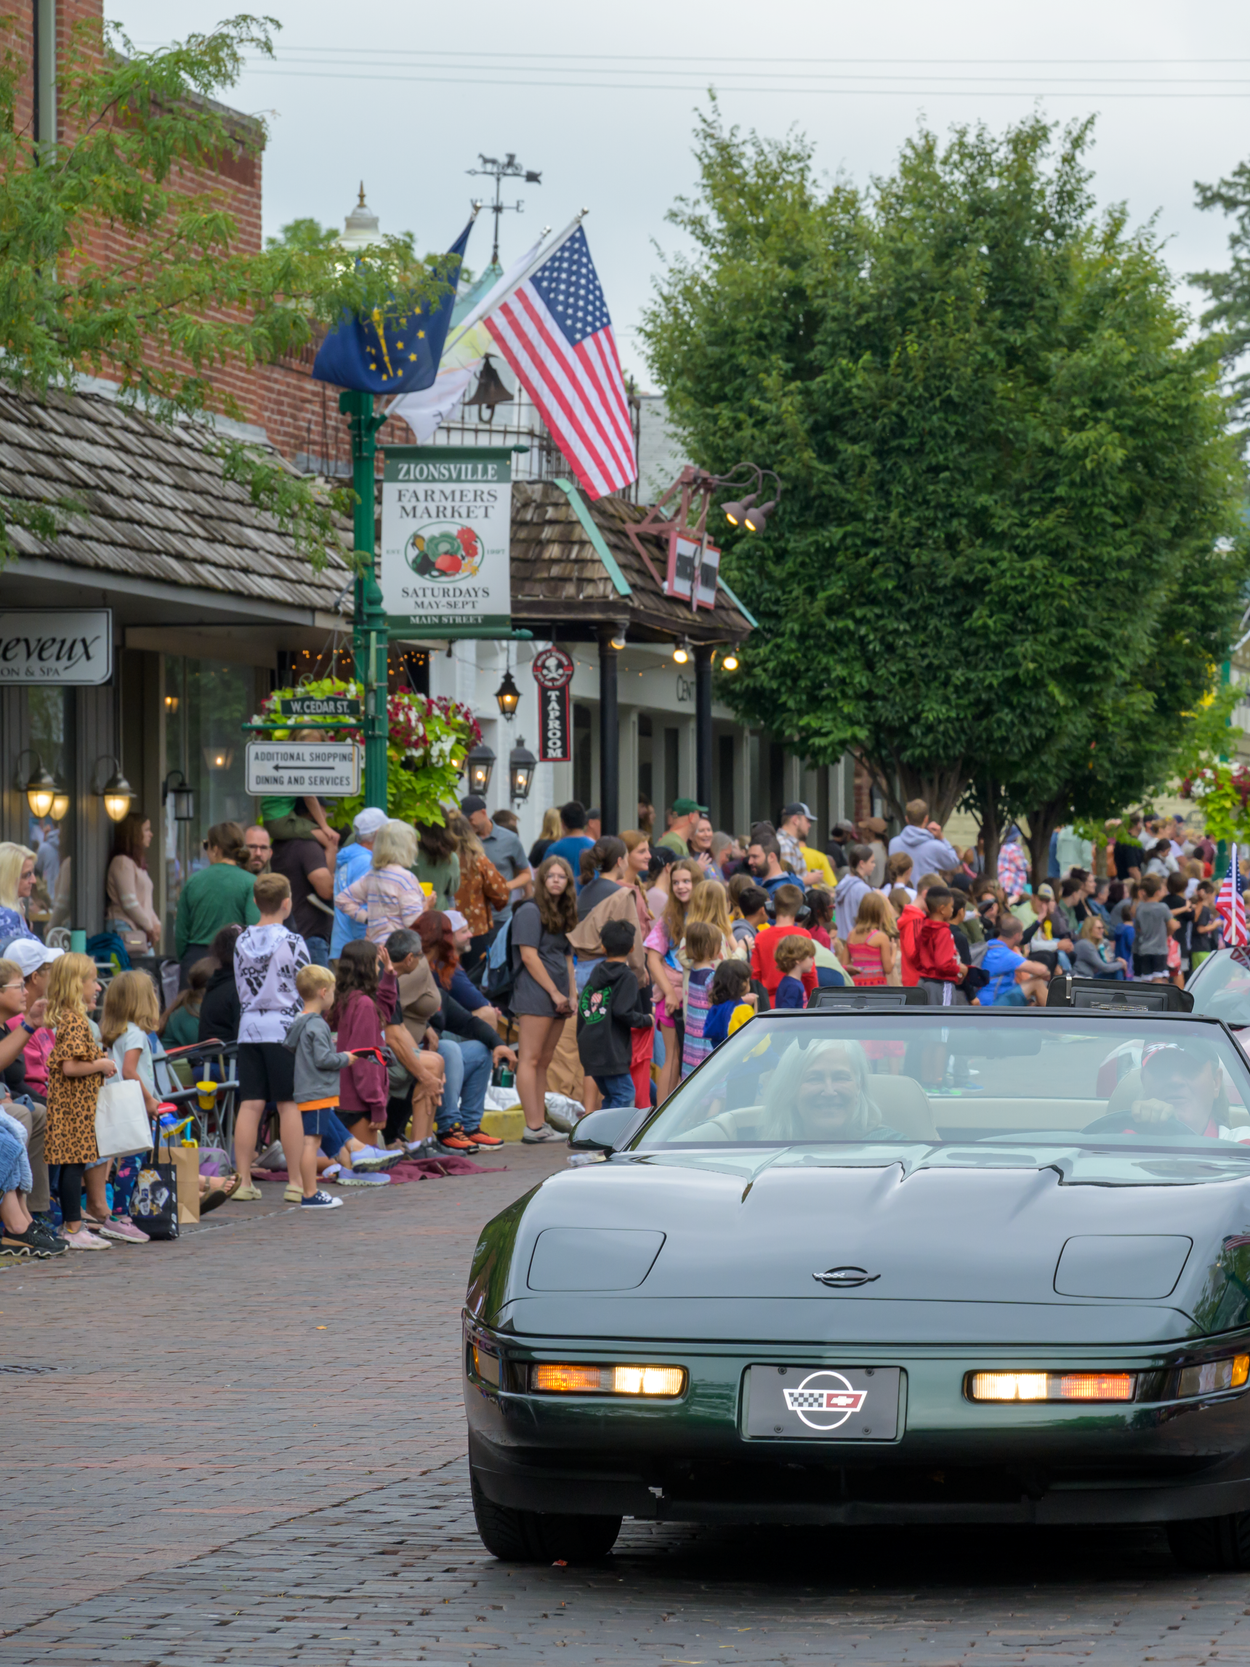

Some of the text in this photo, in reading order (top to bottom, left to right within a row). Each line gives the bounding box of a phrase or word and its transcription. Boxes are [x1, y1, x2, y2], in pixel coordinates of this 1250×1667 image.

[397, 463, 498, 481] ZIONSVILLE
[396, 488, 498, 503] FARMERS
[398, 504, 495, 519] MARKET
[401, 586, 490, 598] SATURDAYS
[413, 600, 478, 609] MAY-SEPT
[410, 615, 484, 624] MAIN STREET
[0, 636, 101, 671] eveux
[0, 666, 60, 677] ON & SPA
[290, 701, 350, 713] W. CEDAR ST.
[547, 690, 563, 758] TAPROOM
[254, 751, 353, 762] ADDITIONAL SHOPPING
[255, 775, 350, 787] DINING AND SERVICES
